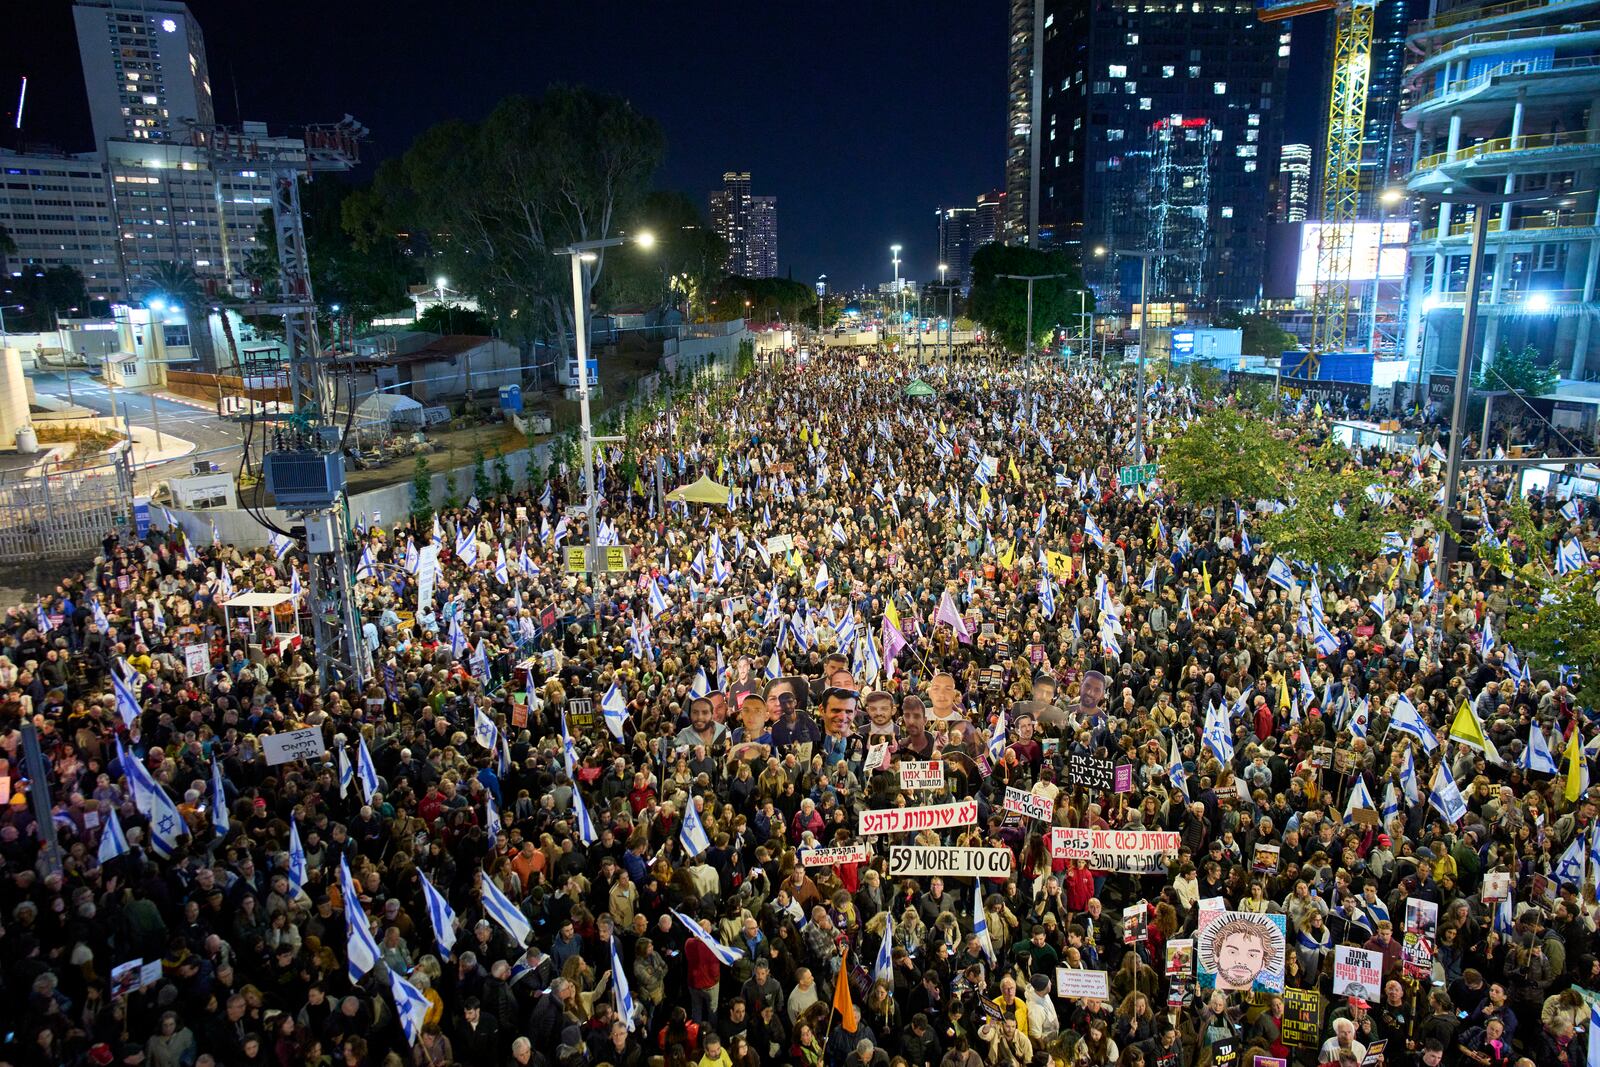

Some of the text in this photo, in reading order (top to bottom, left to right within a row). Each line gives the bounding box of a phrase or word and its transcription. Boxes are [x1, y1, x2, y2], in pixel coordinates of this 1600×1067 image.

[281, 740, 317, 751] חמאס
[1070, 755, 1113, 769] תציל את
[1071, 764, 1113, 779] המדינה
[1069, 773, 1110, 789] מעצמך
[863, 802, 977, 832] לא שוכחות לרגע
[1055, 829, 1073, 839] מחר
[1063, 839, 1089, 849] כולם
[1055, 847, 1089, 857] בירושלים
[891, 848, 1010, 872] 59 MORE TO GO
[1349, 949, 1369, 960] אתה
[1345, 957, 1371, 968] הראש
[1289, 1000, 1316, 1012] נתניהו
[1299, 1010, 1310, 1021] או
[1219, 1045, 1232, 1055] עד
[1215, 1052, 1236, 1065] מתי?
